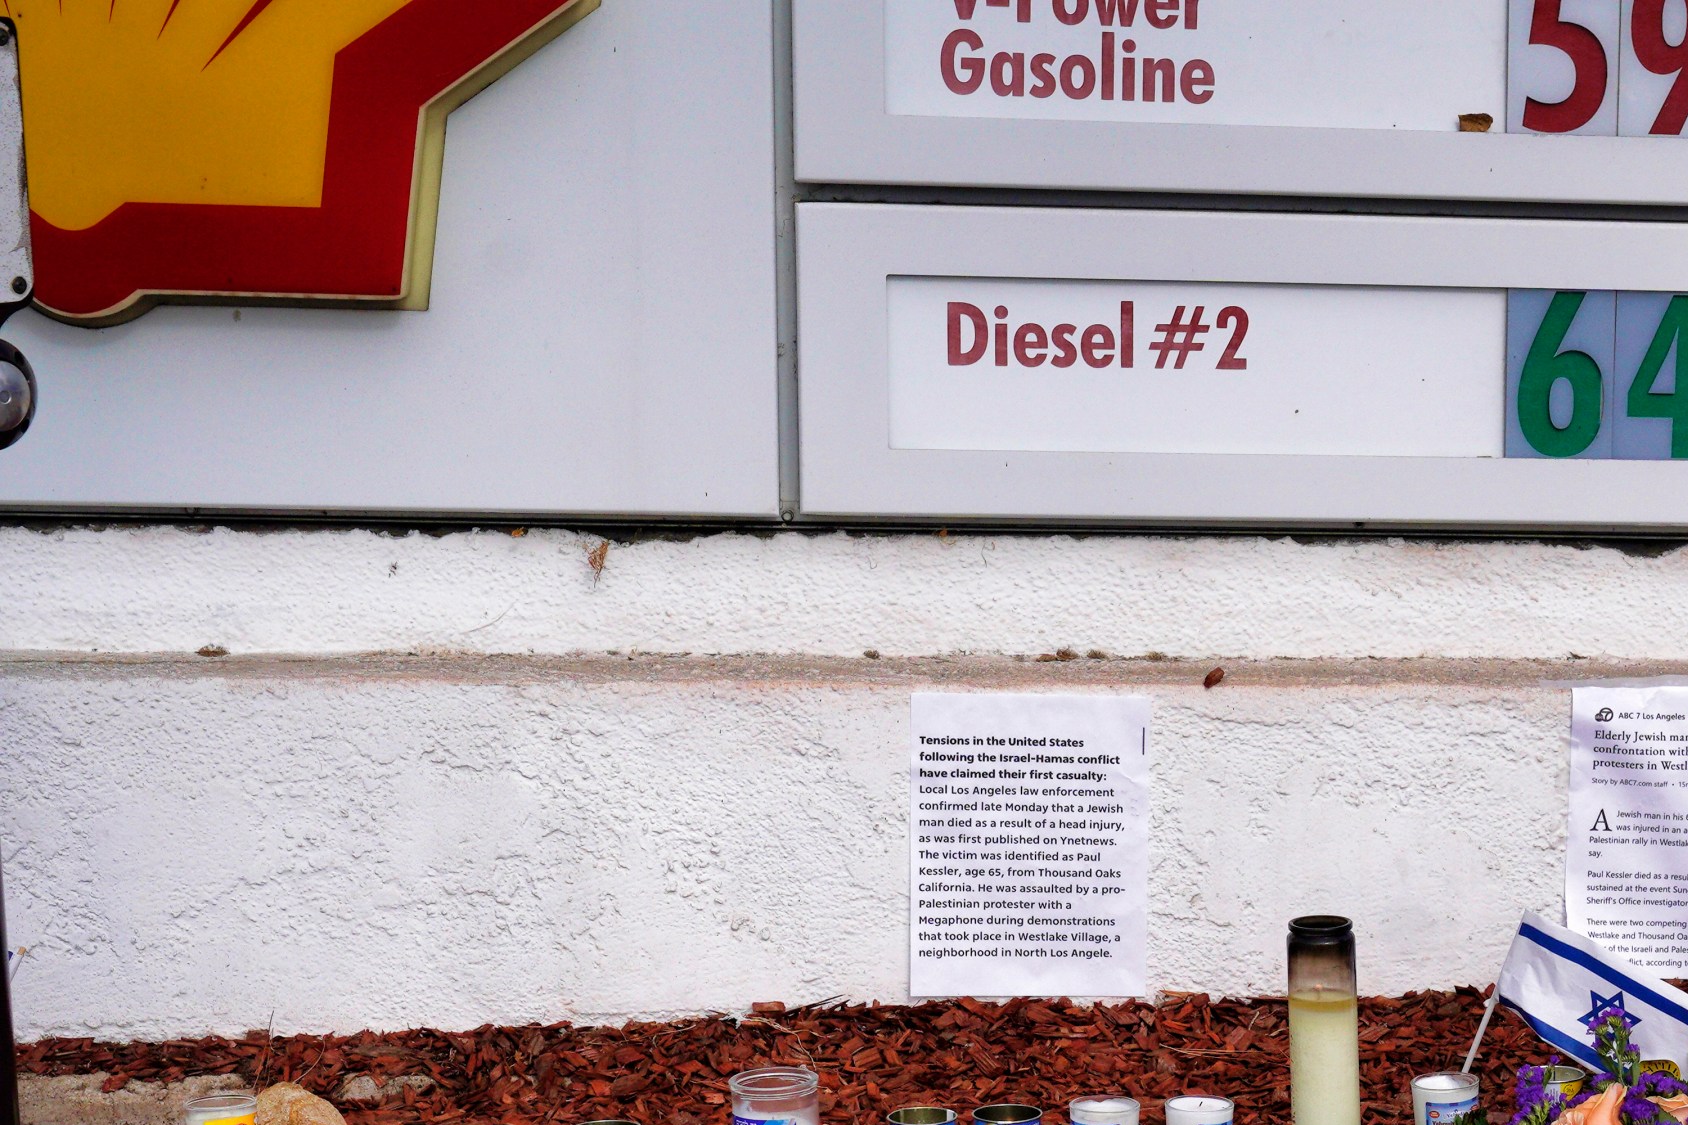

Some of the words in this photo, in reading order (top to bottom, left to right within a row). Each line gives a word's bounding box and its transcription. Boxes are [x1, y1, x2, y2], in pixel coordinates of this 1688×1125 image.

[941, 28, 1214, 104] Gasoline
[947, 301, 1133, 368] Diesel
[1149, 305, 1249, 370] #2
[1642, 712, 1654, 720] Los
[1655, 712, 1685, 721] Angeles
[919, 735, 970, 745] Tensions
[973, 735, 983, 745] in
[986, 736, 1005, 746] the
[1008, 736, 1046, 746] United
[1049, 738, 1084, 747] States
[1594, 729, 1631, 743] Elderly
[1633, 731, 1666, 743] Jewish
[1593, 744, 1665, 755] confrontation
[919, 751, 974, 764] following
[977, 752, 996, 762] the
[999, 753, 1074, 763] Israel-Hamas
[1077, 754, 1120, 764] conflict
[1592, 760, 1644, 769] protesters
[1647, 760, 1657, 770] in
[919, 768, 947, 778] have
[950, 768, 995, 778] claimed
[998, 769, 1026, 779] their
[1029, 769, 1053, 779] first
[1056, 771, 1106, 782] casualty:
[1591, 777, 1608, 785] Story
[1619, 778, 1652, 787] ABC7.com
[919, 784, 947, 794] Local
[951, 785, 969, 794] Los
[972, 785, 1016, 797] Angeles
[1020, 785, 1038, 795] law
[1042, 786, 1114, 797] enforcement
[919, 800, 977, 811] confirmed
[981, 801, 1002, 811] late
[1005, 802, 1048, 814] Monday
[1051, 803, 1074, 812] that
[1086, 803, 1123, 813] Jewish
[1590, 809, 1612, 831] A
[1616, 810, 1641, 818] Jewish
[1663, 812, 1670, 820] in
[1672, 812, 1683, 821] his
[947, 817, 971, 827] died
[990, 820, 996, 828] a
[1000, 818, 1031, 828] result
[1034, 818, 1046, 828] of
[1059, 819, 1086, 829] head
[1089, 819, 1124, 831] injury,
[1633, 823, 1660, 833] injured
[1662, 825, 1669, 833] in
[918, 835, 930, 843] as
[933, 835, 955, 843] was
[958, 833, 981, 843] first
[984, 834, 1039, 845] published
[1060, 836, 1116, 845] Ynetnews.
[1589, 835, 1629, 844] Palestinian
[1631, 836, 1648, 846] rally
[1650, 837, 1657, 845] in
[918, 849, 939, 859] The
[942, 849, 977, 859] victim
[980, 852, 1001, 860] was
[1005, 850, 1058, 861] identified
[1077, 852, 1100, 861] Paul
[1588, 850, 1602, 858] say.
[919, 866, 961, 877] Kessler,
[964, 868, 985, 878] age
[988, 868, 1004, 878] 65,
[1007, 866, 1034, 877] from
[1038, 867, 1092, 877] Thousand
[1095, 868, 1121, 878] Oaks
[918, 882, 974, 892] California.
[978, 883, 992, 892] He
[1019, 884, 1072, 893] assaulted
[1076, 884, 1089, 895] by
[1092, 886, 1098, 894] a
[1101, 886, 1125, 895] pro-
[919, 898, 979, 908] Palestinian
[983, 900, 1035, 910] protester
[1038, 899, 1062, 909] with
[919, 915, 983, 926] Megaphone
[986, 915, 1023, 927] during
[1027, 916, 1115, 926] demonstrations
[918, 931, 941, 941] that
[944, 931, 969, 940] took
[972, 931, 1001, 942] place
[1004, 931, 1014, 941] in
[1018, 931, 1067, 941] Westlake
[1071, 932, 1111, 944] Village,
[1114, 934, 1120, 942] a
[919, 947, 997, 959] neighborhood
[1001, 947, 1011, 956] in
[1015, 947, 1047, 957] North
[1050, 949, 1068, 957] Los
[1071, 948, 1112, 959] Angele.
